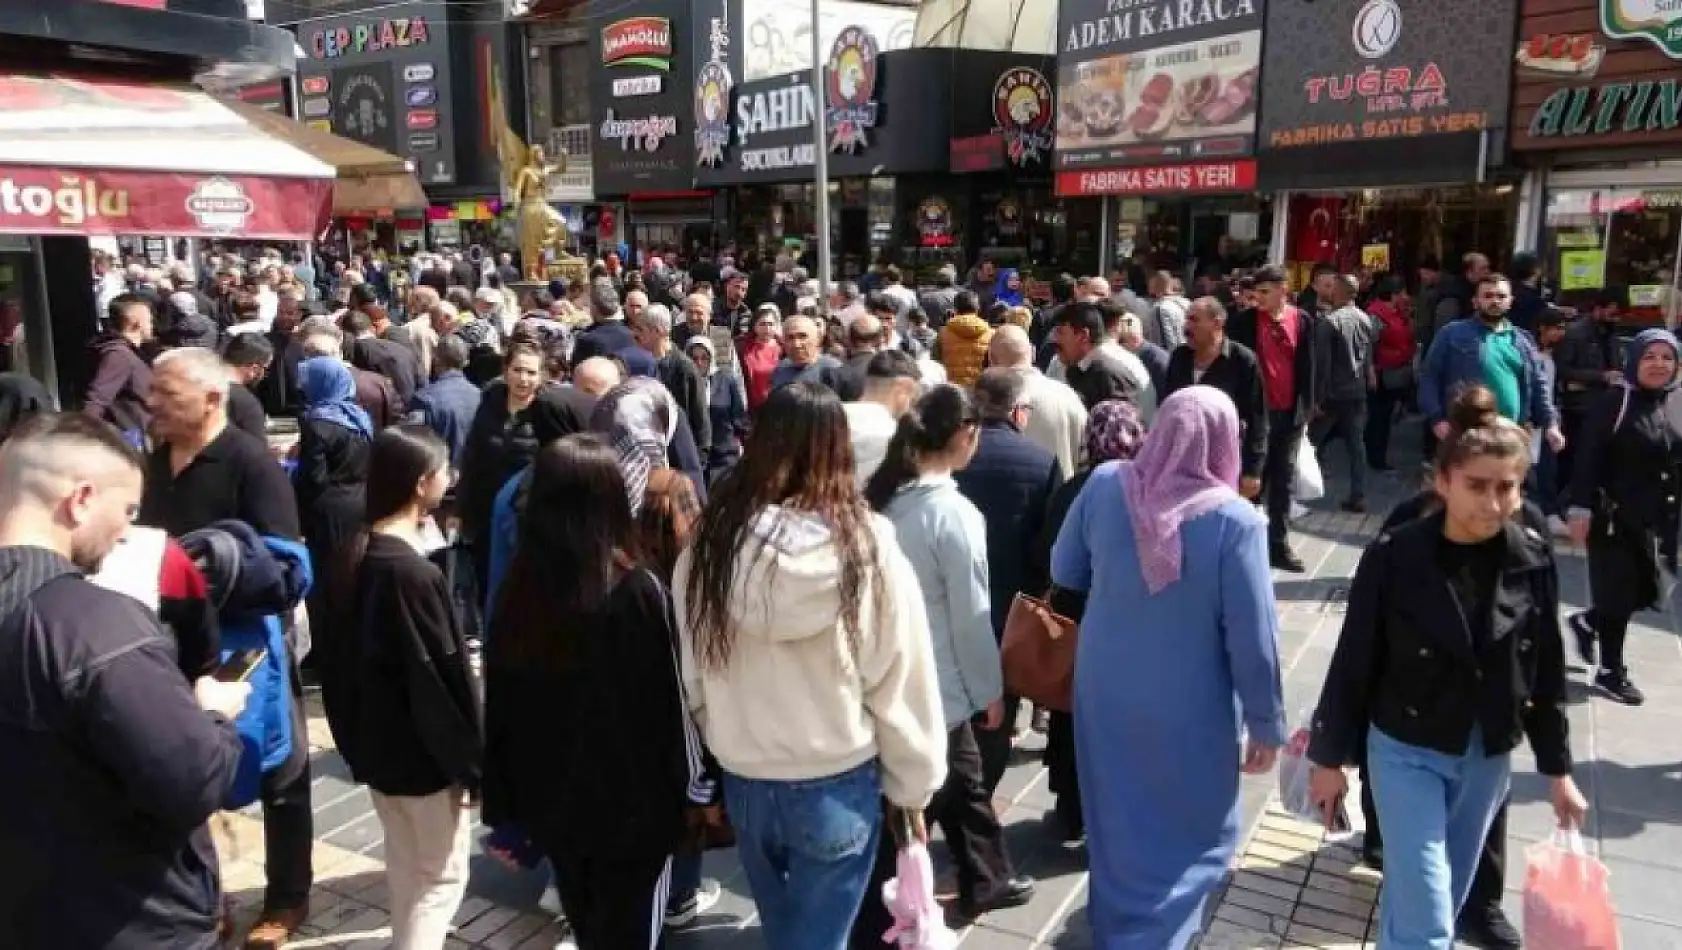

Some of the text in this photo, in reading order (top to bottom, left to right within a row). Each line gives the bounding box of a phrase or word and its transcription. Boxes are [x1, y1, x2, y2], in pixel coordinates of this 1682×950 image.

[311, 15, 428, 61] CEP PLAZA
[1065, 12, 1134, 51] ADEM
[1304, 62, 1446, 103] TUĞRA
[1144, 165, 1191, 191] SATIŞ
